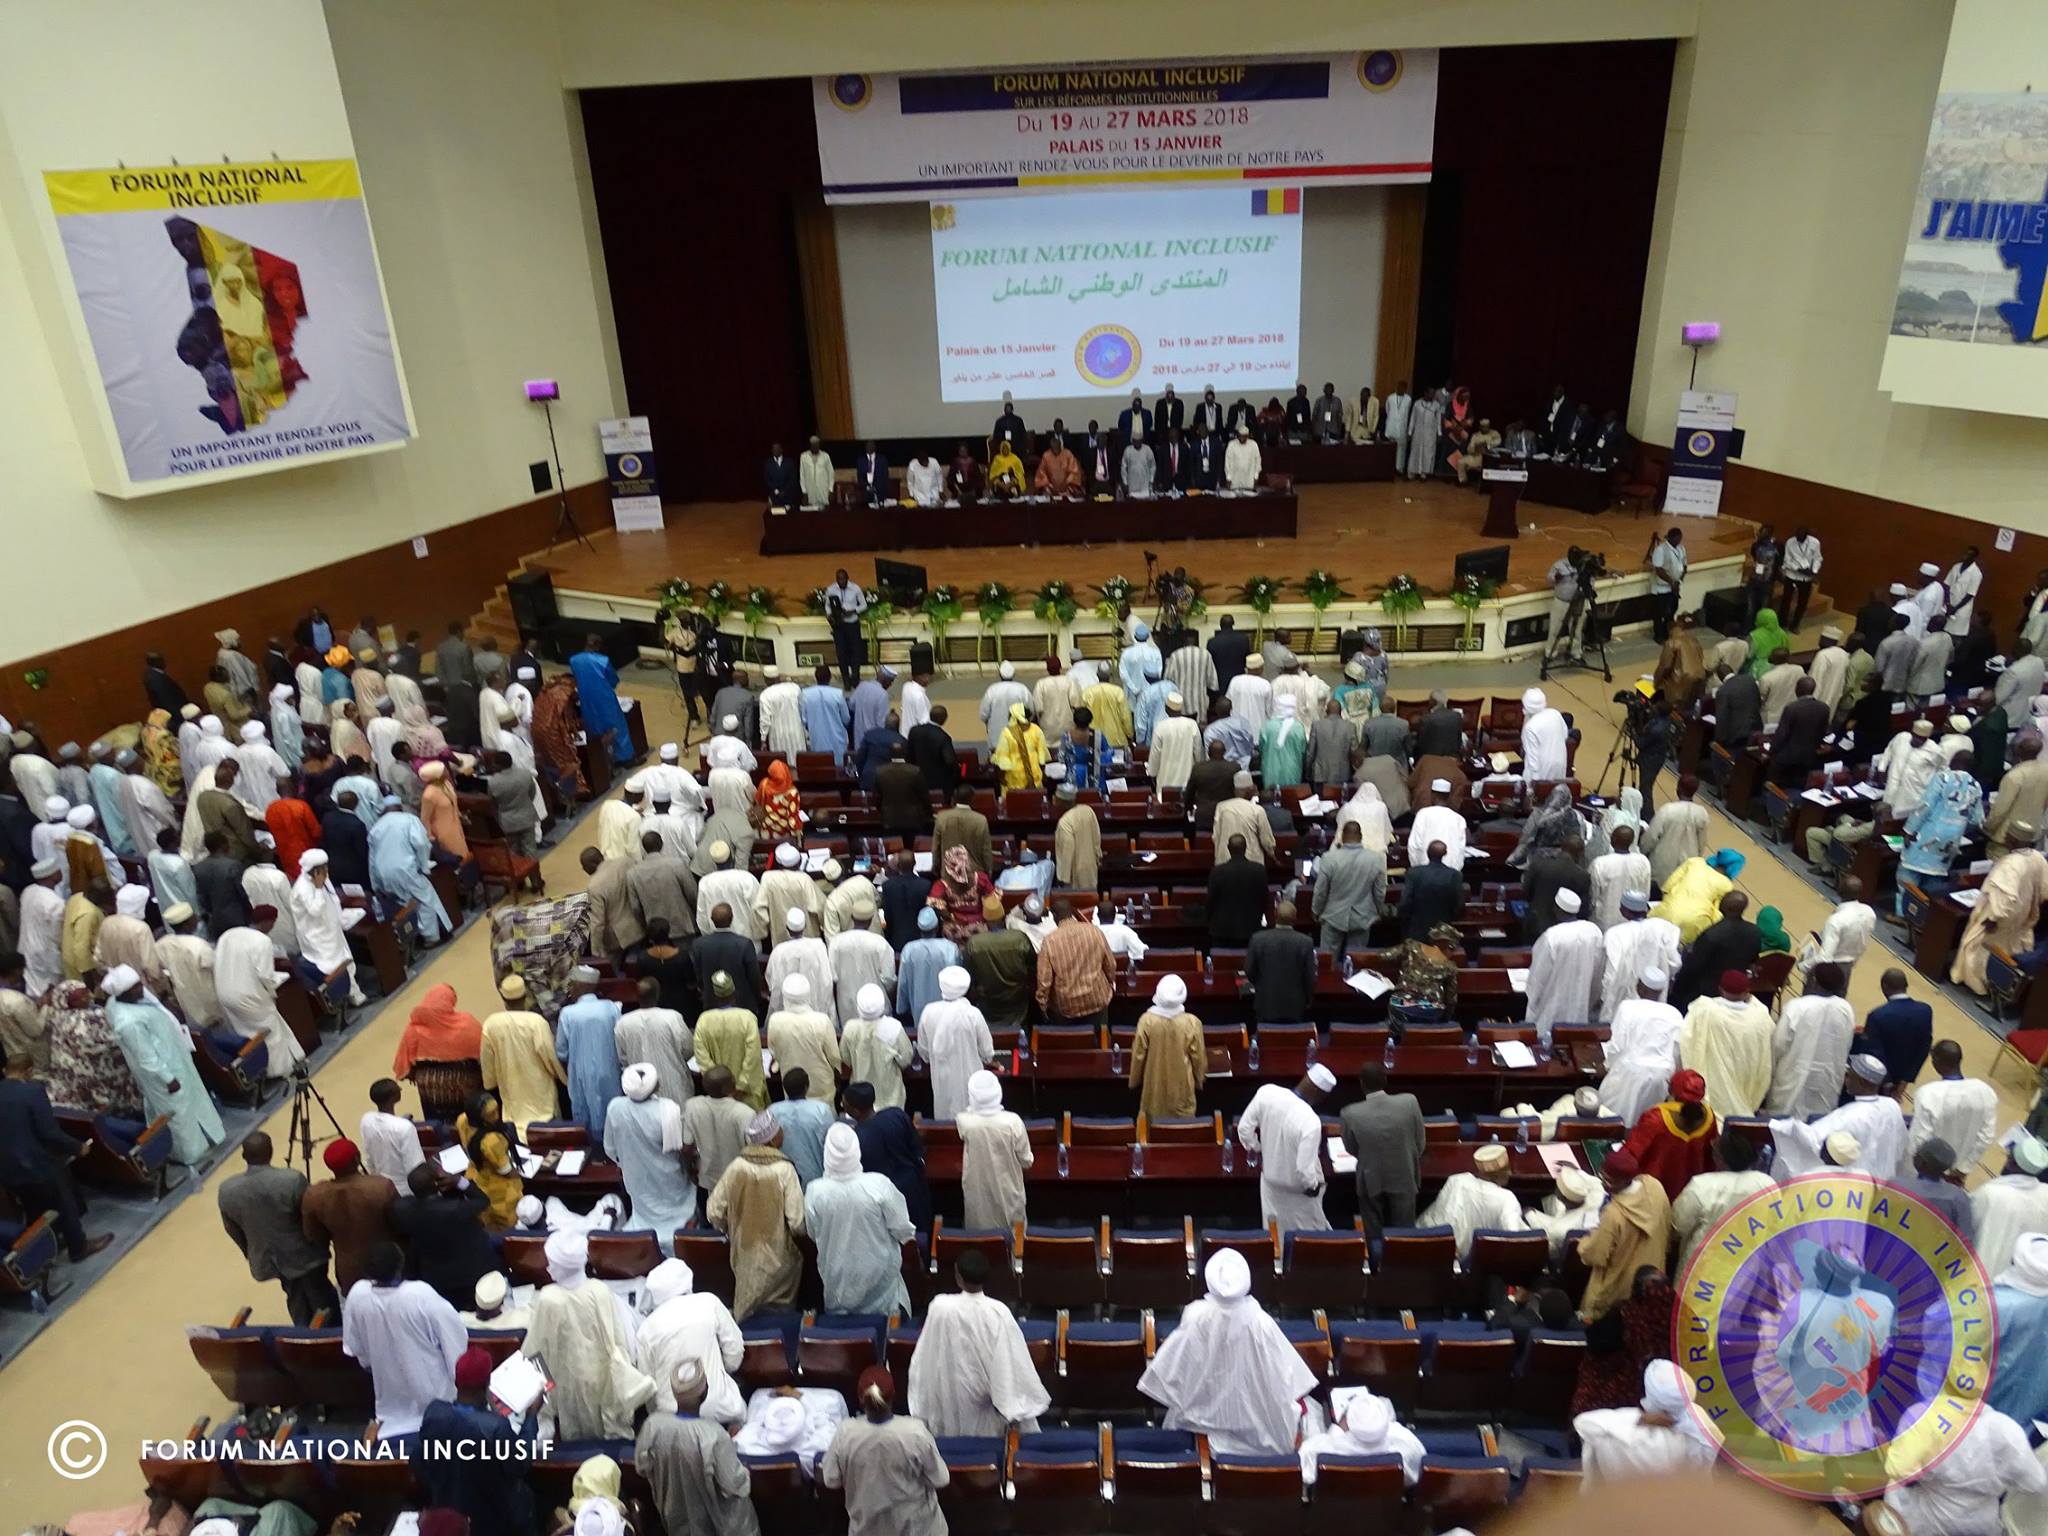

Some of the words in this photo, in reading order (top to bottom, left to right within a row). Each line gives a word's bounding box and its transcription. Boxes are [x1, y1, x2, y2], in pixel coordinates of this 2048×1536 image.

[993, 71, 1060, 92] FORUM
[1065, 68, 1159, 90] NATIONAL
[1164, 65, 1246, 86] INCLUSIF
[1014, 95, 1036, 109] SUR
[1039, 95, 1056, 108] LES
[1115, 89, 1218, 105] INSTITUTIONNELLES
[1017, 114, 1042, 133] Du
[1050, 112, 1073, 131] 19
[1079, 115, 1100, 131] AU
[1106, 110, 1130, 129] 27
[1136, 108, 1197, 128] MARS
[1203, 106, 1249, 126] 2018
[1049, 138, 1104, 154] PALAIS
[1108, 139, 1127, 152] DU
[1134, 137, 1150, 151] 15
[1154, 134, 1222, 151] JANVIER
[918, 164, 938, 177] UN
[941, 160, 1015, 176] IMPORTANT
[1113, 154, 1149, 169] POUR
[1152, 154, 1166, 168] LE
[1169, 153, 1224, 168] DEVENIR
[1227, 152, 1243, 166] DE
[1248, 151, 1291, 164] NOTRE
[1294, 149, 1325, 162] PAYS
[110, 170, 194, 193] FORUM
[199, 166, 308, 189] NATIONAL
[167, 186, 264, 209] INCLUSIF
[1919, 198, 2048, 244] J'AIME
[940, 246, 1029, 269] FORUM
[1034, 238, 1158, 265] NATIONAL
[1164, 233, 1280, 257] INCLUSIF
[945, 346, 979, 356] Palais
[982, 344, 997, 355] du
[1015, 342, 1057, 354] Janvier
[1158, 338, 1175, 348] Du
[1211, 336, 1223, 347] 27
[1227, 335, 1254, 345] Mars
[1258, 333, 1284, 344] 2018
[1152, 364, 1179, 375] 2018
[1207, 362, 1220, 373] 27
[169, 458, 208, 475] POUR
[210, 457, 226, 470] LE
[228, 446, 284, 467] DEVENIR
[286, 444, 302, 457] DE
[304, 438, 345, 454] NOTRE
[348, 432, 376, 446] PAYS
[171, 445, 193, 459] UN
[194, 434, 273, 455] IMPORTANT
